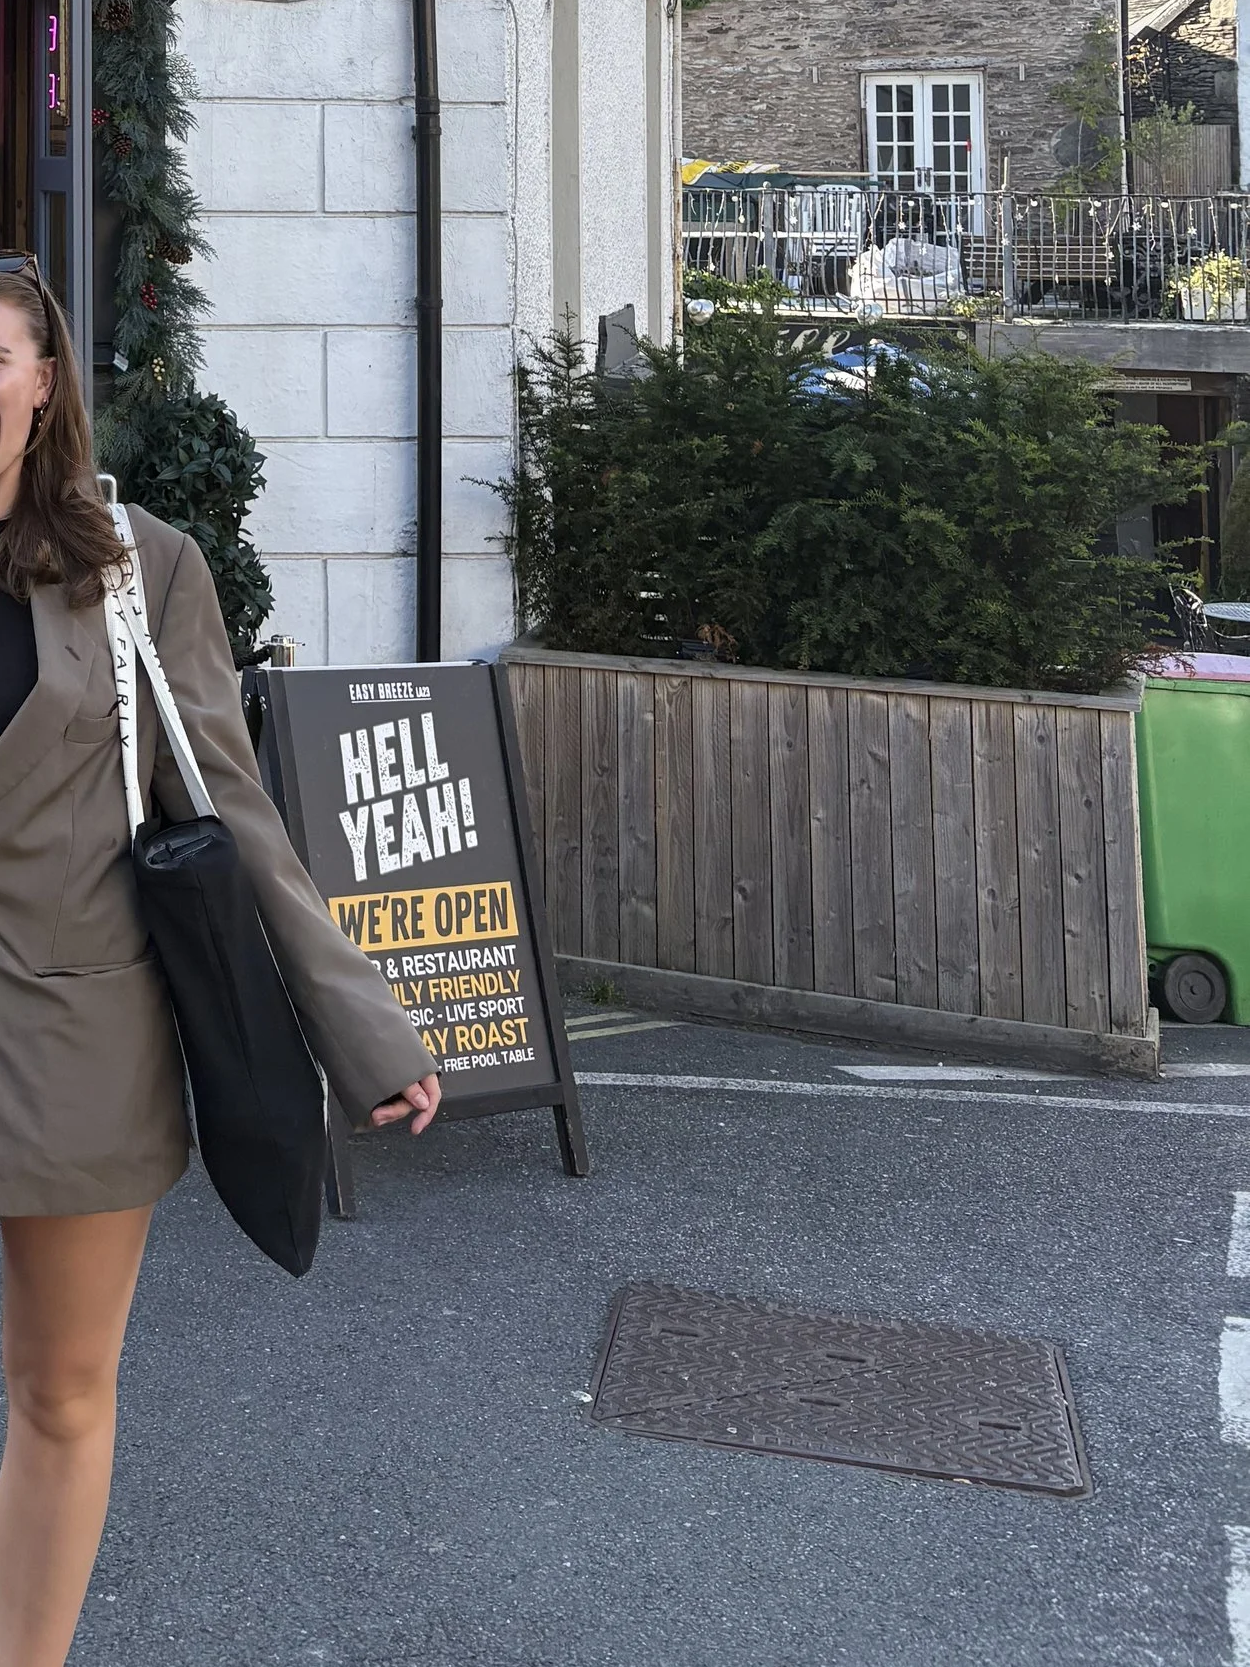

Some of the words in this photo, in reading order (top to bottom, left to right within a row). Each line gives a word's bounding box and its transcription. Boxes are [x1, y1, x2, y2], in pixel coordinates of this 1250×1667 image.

[349, 684, 375, 700] EASY
[378, 682, 414, 699] BREEZE
[416, 686, 430, 698] LA23
[338, 712, 449, 805] HELL
[338, 778, 479, 883] YEAH!
[338, 895, 425, 945] WE'RE
[434, 888, 508, 937] OPEN
[386, 957, 399, 979] &
[402, 944, 516, 977] RESTAURANT
[428, 969, 521, 1002] FRIENDLY
[445, 1003, 477, 1023] LIVE
[479, 996, 525, 1017] SPORT
[455, 1017, 529, 1053] ROAST
[444, 1056, 470, 1073] FREE
[472, 1053, 500, 1069] POOL
[501, 1047, 535, 1066] TABLE
